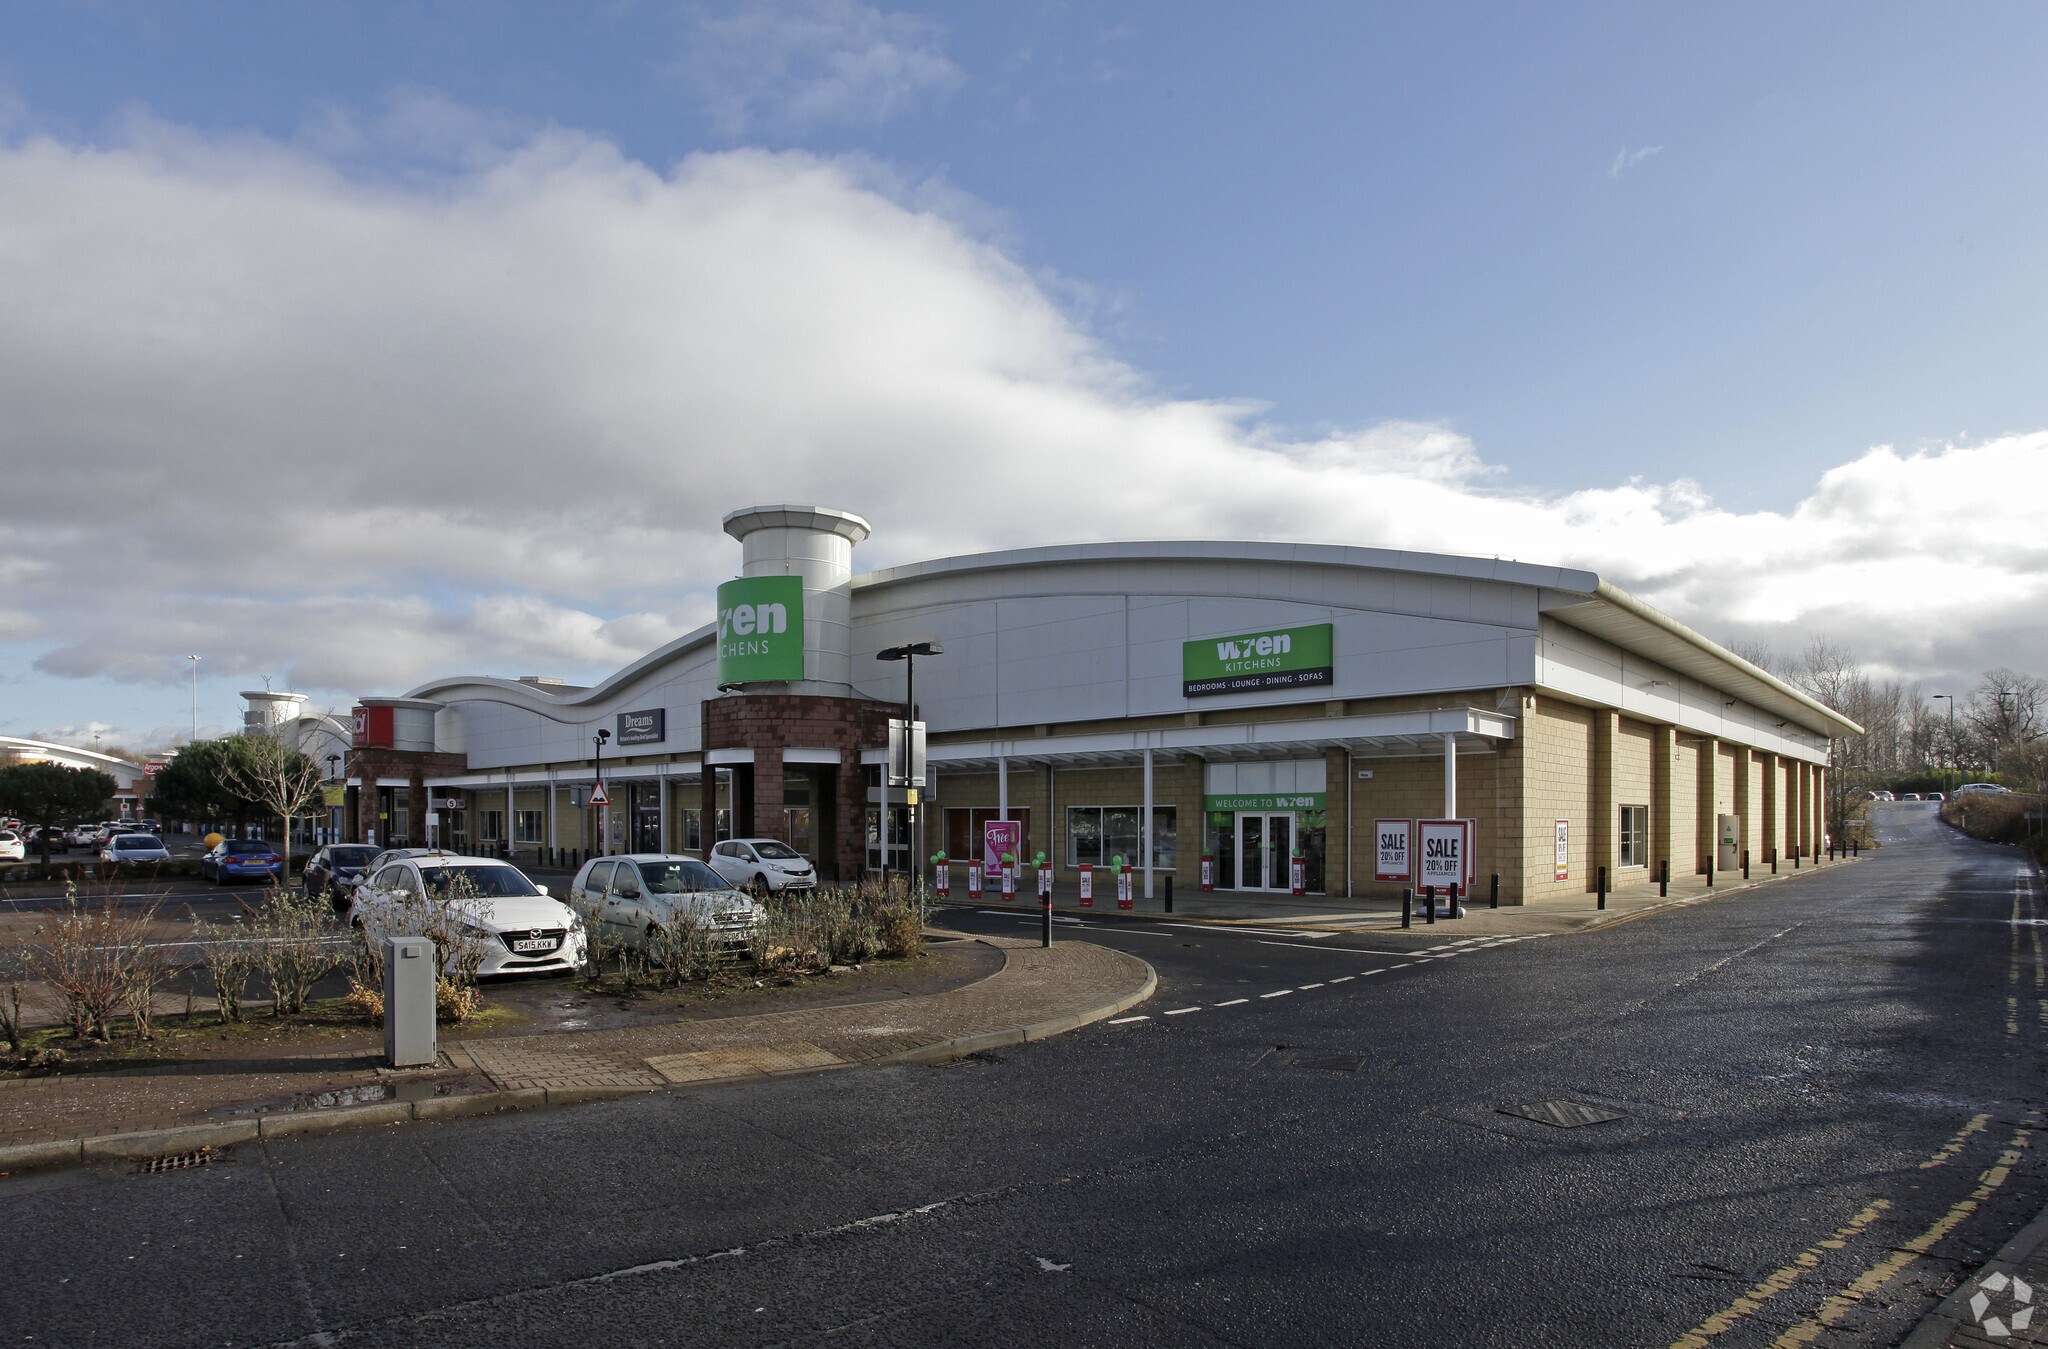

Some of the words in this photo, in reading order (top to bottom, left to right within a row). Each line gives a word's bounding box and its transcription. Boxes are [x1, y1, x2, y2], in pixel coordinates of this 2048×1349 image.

[720, 603, 787, 640] ren
[1217, 634, 1290, 661] wren
[1226, 658, 1281, 671] KITCHENS
[1189, 682, 1226, 692] BEDROOMS
[1232, 679, 1260, 688] LOUNGE
[1267, 676, 1293, 685] DINING
[1299, 673, 1323, 682] SOFAS
[625, 715, 653, 728] Dreams
[1216, 800, 1257, 808] WELCOME
[1261, 799, 1272, 807] TO
[1277, 797, 1314, 807] wren
[987, 829, 1010, 846] Free
[1381, 834, 1405, 850] SALE
[1427, 838, 1458, 858] SALE
[1381, 852, 1393, 861] 20%
[1395, 852, 1405, 861] OFF
[1426, 860, 1442, 870] 20%
[1445, 861, 1457, 871] OFF
[519, 941, 536, 950] SA15
